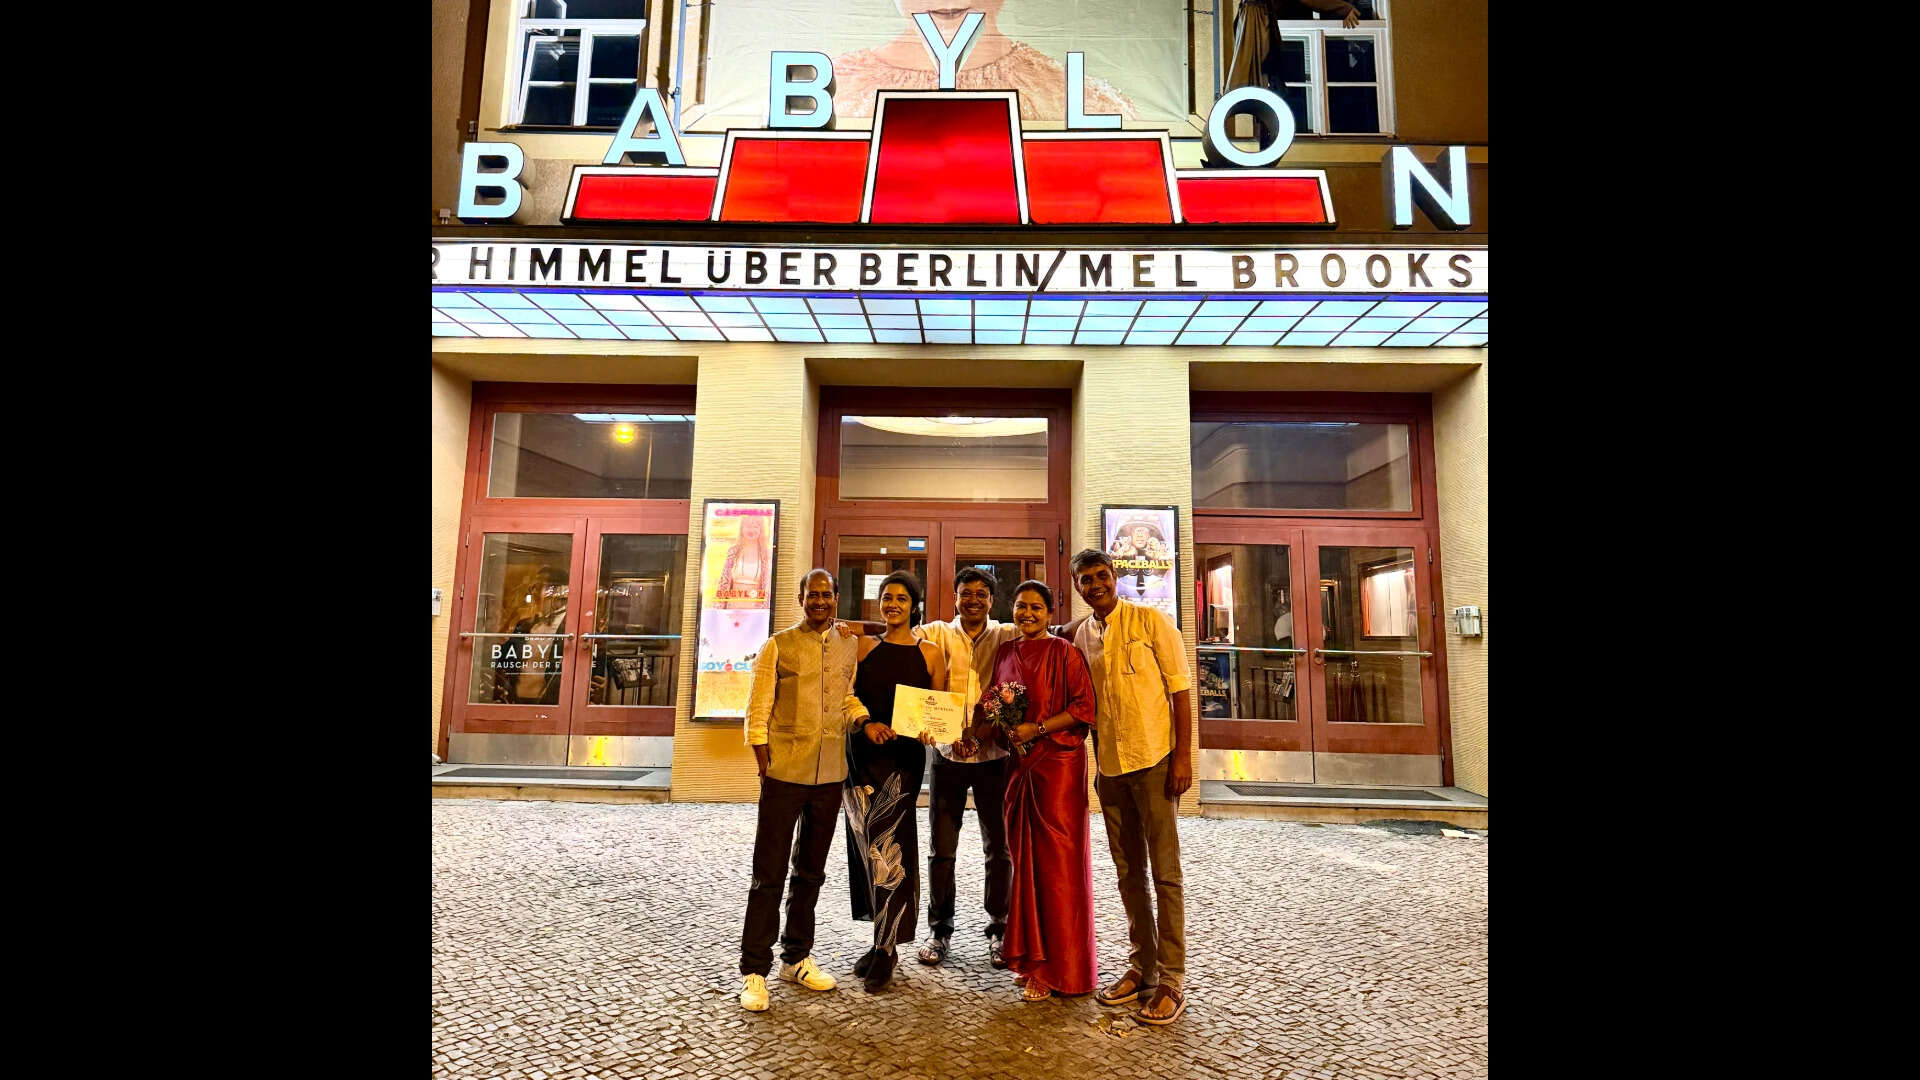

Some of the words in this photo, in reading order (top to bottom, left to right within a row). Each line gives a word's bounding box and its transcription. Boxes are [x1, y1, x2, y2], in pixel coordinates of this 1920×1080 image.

[457, 12, 1471, 229] BABYLON
[468, 246, 682, 282] HIMMEL
[707, 250, 837, 286] ÜBER
[1232, 253, 1473, 289] BROOKS
[490, 661, 528, 669] RAUSCH
[532, 661, 551, 669] DER
[491, 644, 598, 659] BABYL
